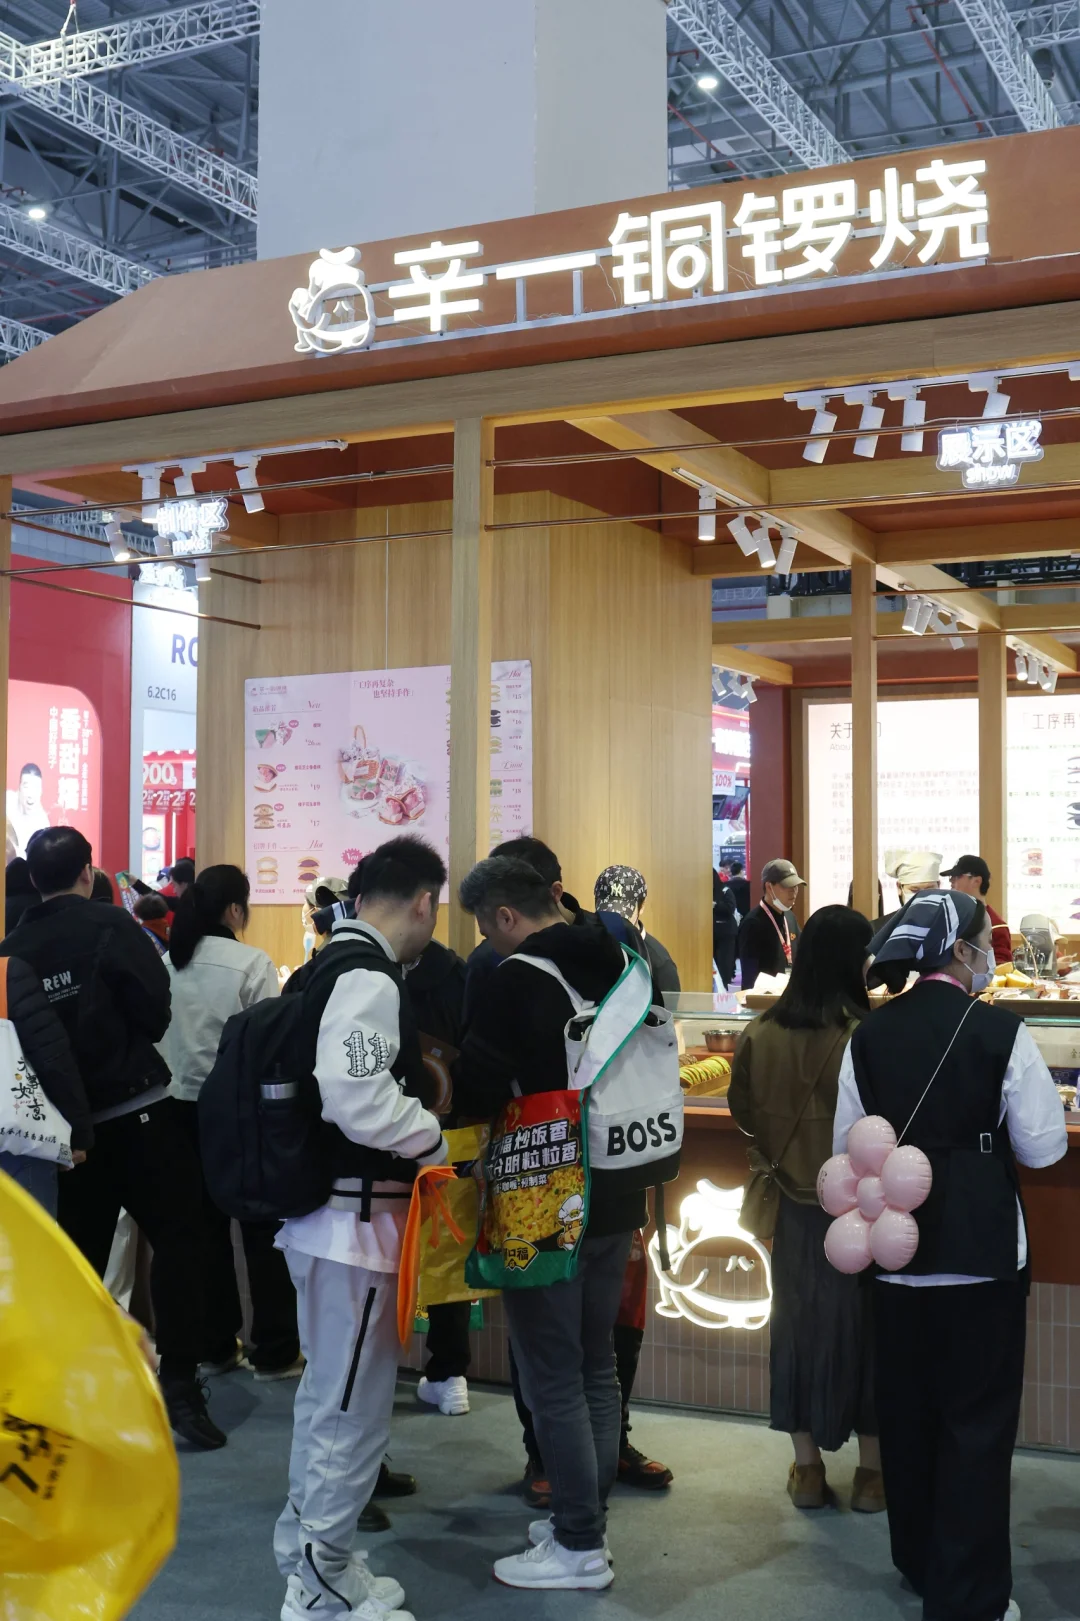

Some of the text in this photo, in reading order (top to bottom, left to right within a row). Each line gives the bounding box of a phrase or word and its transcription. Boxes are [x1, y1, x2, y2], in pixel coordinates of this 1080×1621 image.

[388, 158, 990, 334] 辛一铜锣烧
[940, 424, 1041, 467] 展示区
[966, 463, 1017, 484] show
[157, 502, 224, 535] 制作区
[147, 685, 177, 701] 6.2C16
[606, 1112, 678, 1157] BOSS
[504, 1247, 529, 1261] 口福
